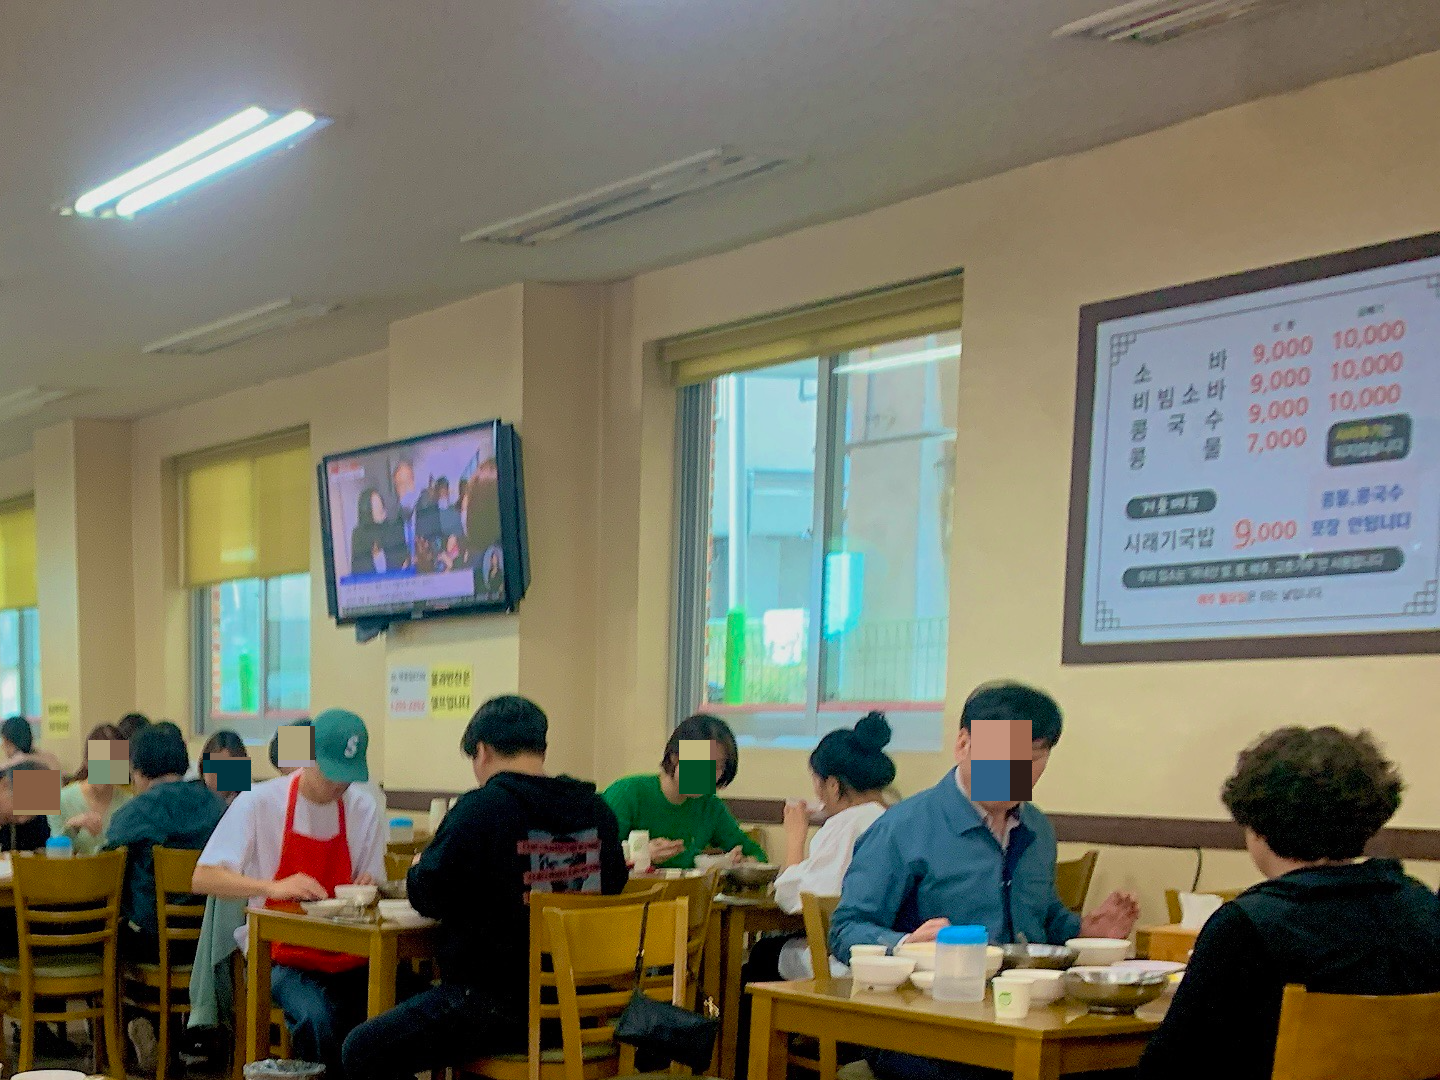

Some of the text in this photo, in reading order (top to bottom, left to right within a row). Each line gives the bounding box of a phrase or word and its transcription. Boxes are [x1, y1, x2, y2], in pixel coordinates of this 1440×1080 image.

[1253, 335, 1314, 365] 9,000
[1333, 320, 1406, 350] 10,000
[1250, 366, 1312, 395] 9,000
[1331, 351, 1404, 381] 10,000
[1248, 396, 1309, 425] 9,000
[1329, 383, 1401, 412] 10,000
[1247, 426, 1308, 454] 7,000
[1123, 518, 1298, 554] 시래기국밥 9,000
